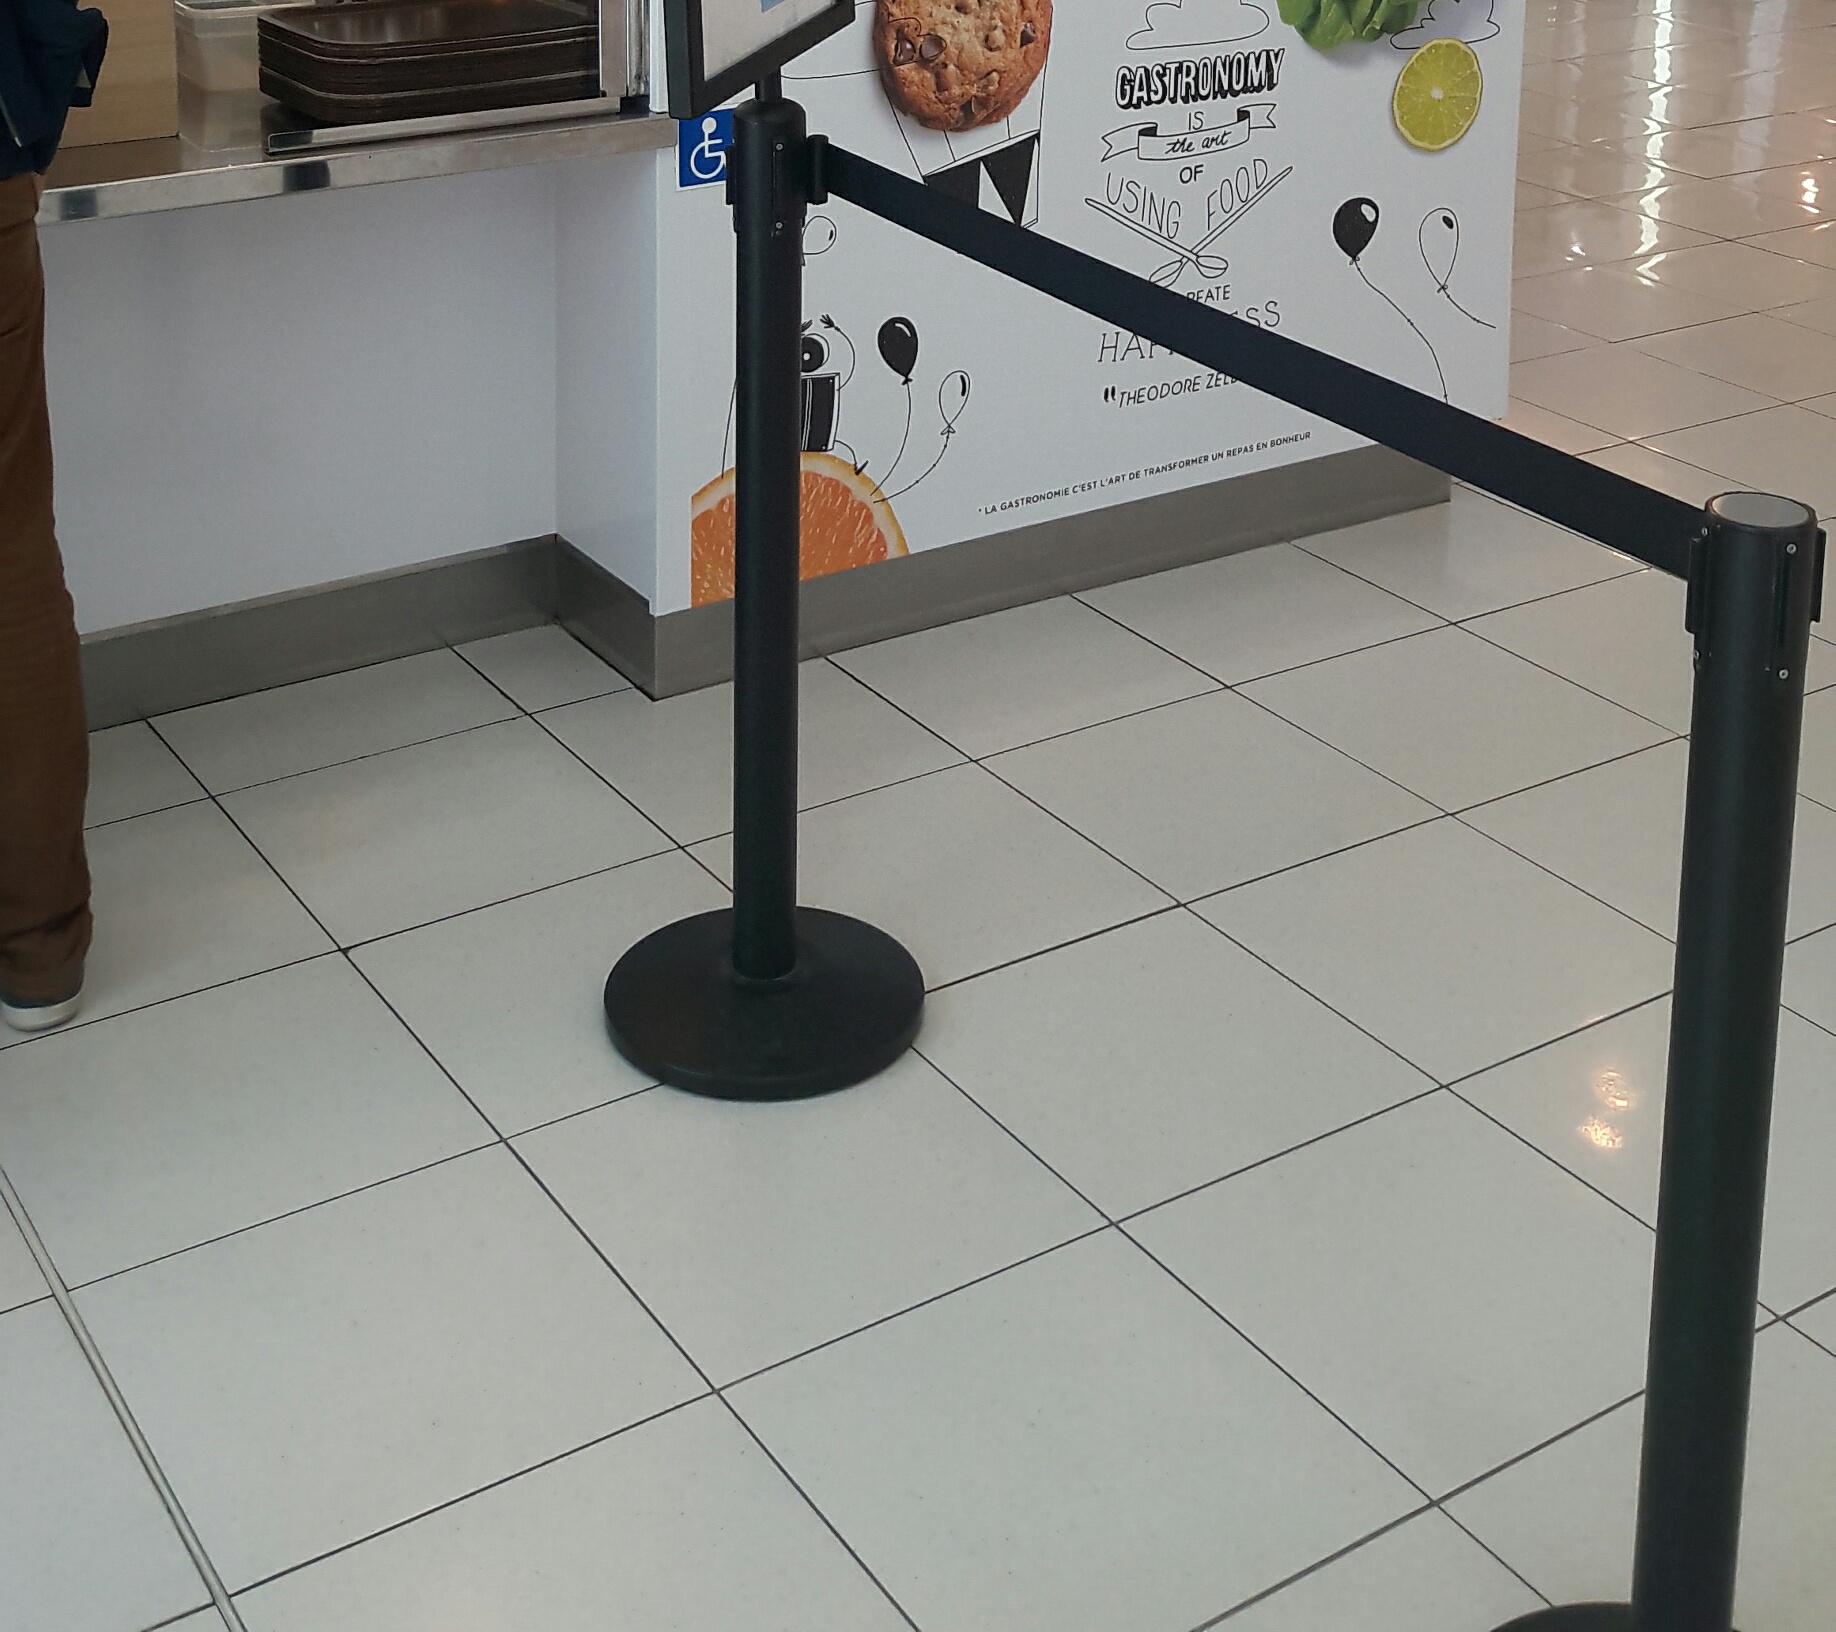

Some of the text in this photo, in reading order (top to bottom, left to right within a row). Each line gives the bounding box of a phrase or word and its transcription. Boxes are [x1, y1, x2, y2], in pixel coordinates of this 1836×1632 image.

[1114, 48, 1285, 110] GASTRONOMY
[1165, 130, 1232, 155] the art
[1187, 111, 1204, 131] IS
[1179, 164, 1204, 184] OF
[1106, 158, 1270, 239] USING FOOD
[984, 430, 1312, 516] LA GASTRONOMIE C'EST L'ART DE TRANSFORMER UN REPAS EN BONHEUR
